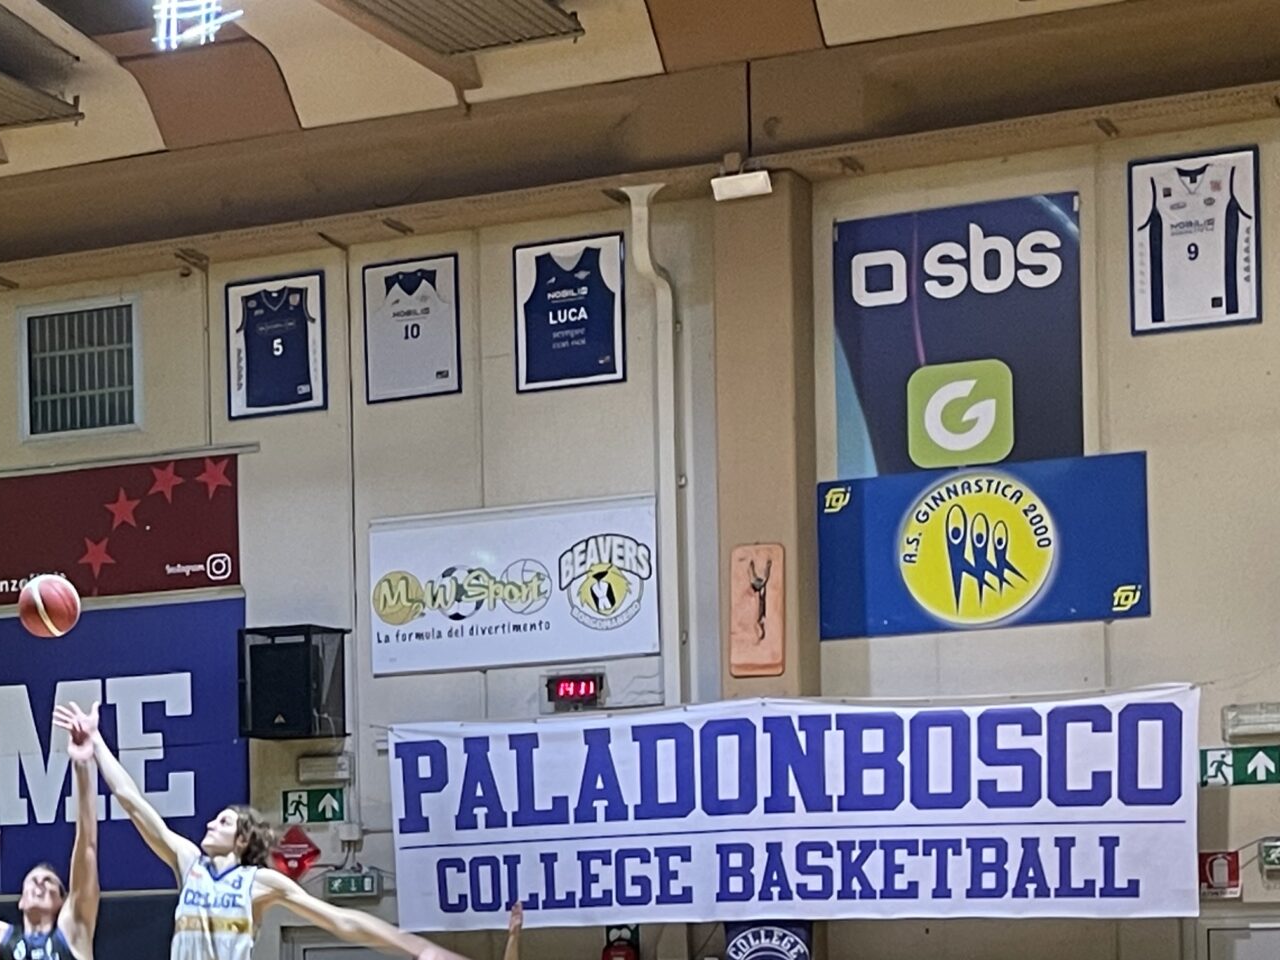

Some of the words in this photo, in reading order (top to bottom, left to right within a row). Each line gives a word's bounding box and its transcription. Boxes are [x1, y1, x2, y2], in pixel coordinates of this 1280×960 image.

[923, 223, 1063, 299] sbs
[1187, 242, 1199, 261] 9
[403, 323, 420, 340] 10
[548, 307, 588, 325] LUCA
[273, 338, 283, 356] 5
[916, 478, 1024, 525] GINNASTICA
[1022, 503, 1052, 548] 2000
[559, 533, 652, 591] BEAVERS
[376, 631, 390, 644] La
[396, 628, 442, 643] formula
[447, 625, 464, 638] del
[469, 620, 551, 636] divertimento
[395, 702, 1183, 834] PALADONBOSCO
[436, 845, 693, 914] COLLEGE
[715, 836, 1141, 902] BASKETBALL
[728, 928, 804, 960] COLLEGE
